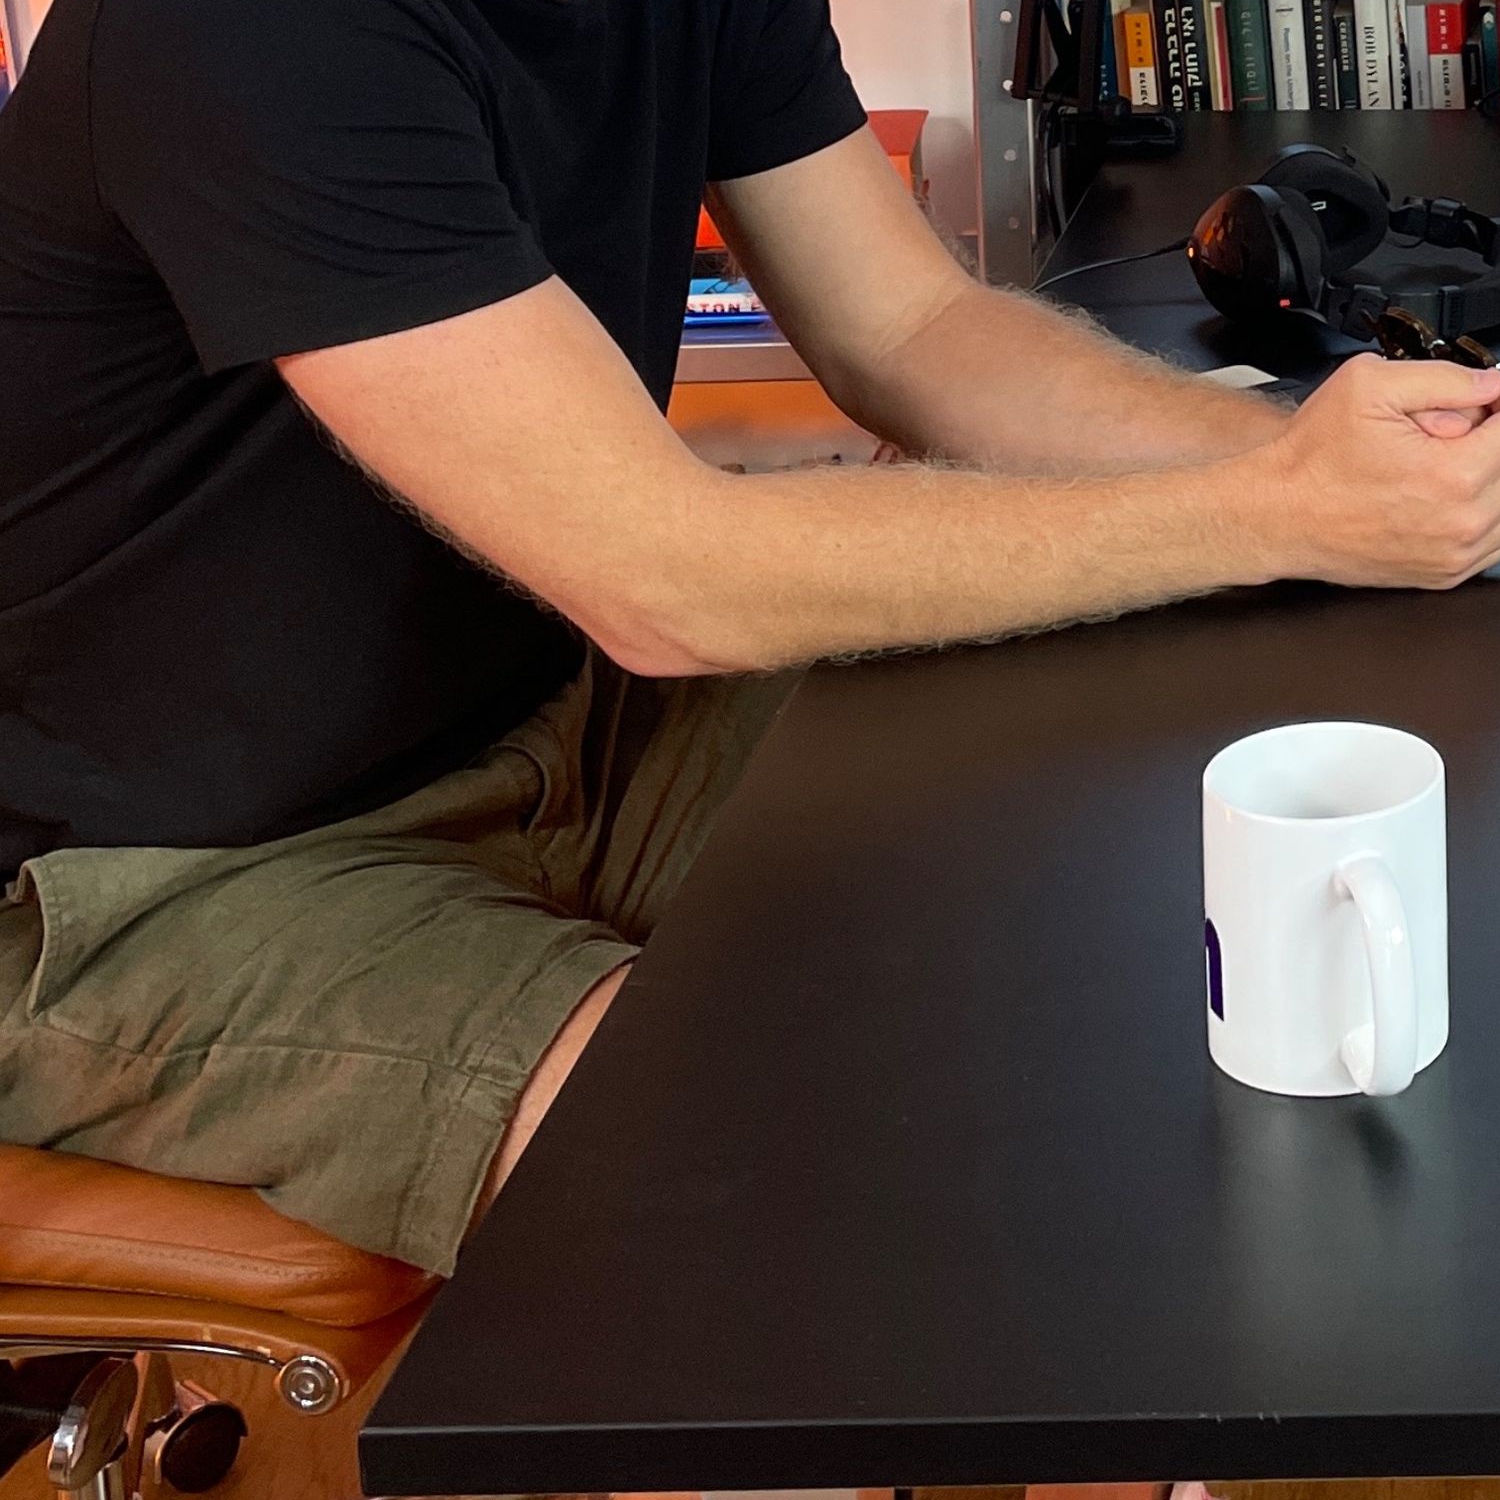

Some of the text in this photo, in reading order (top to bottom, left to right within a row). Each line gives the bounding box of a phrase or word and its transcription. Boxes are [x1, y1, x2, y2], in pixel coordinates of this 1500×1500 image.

[1163, 8, 1181, 79] ברברה
[1181, 6, 1195, 37] ראי
[1184, 42, 1203, 88] רחוק
[1364, 26, 1380, 108] BOB DYLAN
